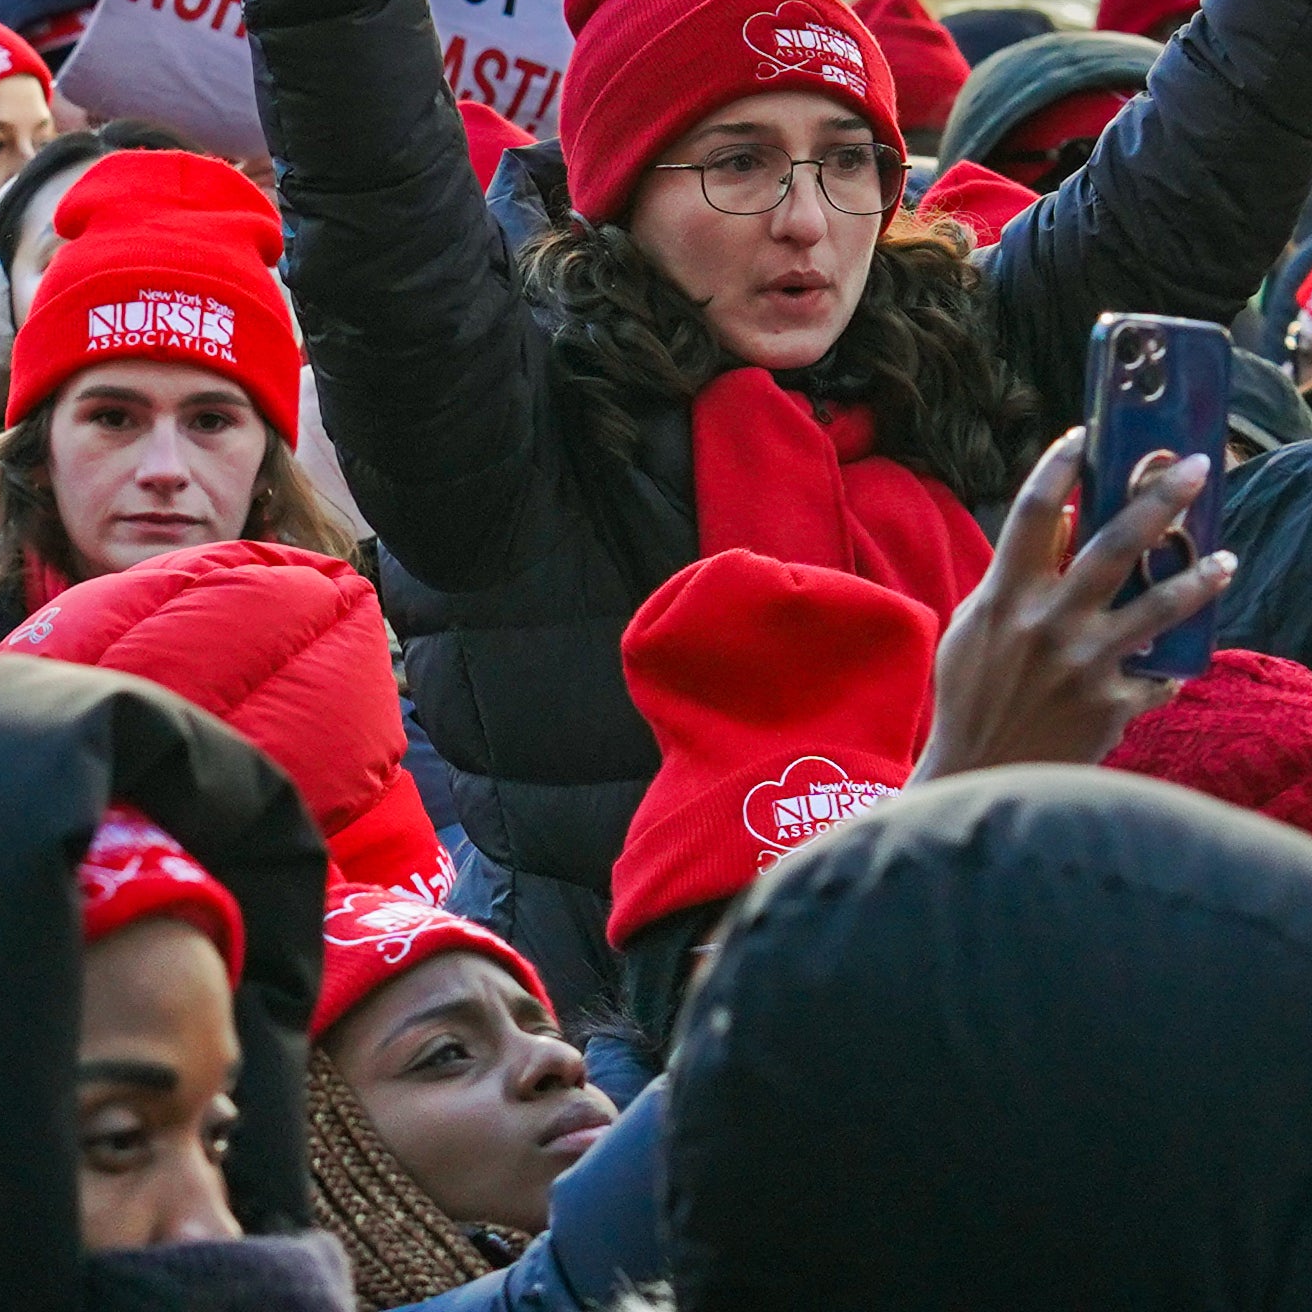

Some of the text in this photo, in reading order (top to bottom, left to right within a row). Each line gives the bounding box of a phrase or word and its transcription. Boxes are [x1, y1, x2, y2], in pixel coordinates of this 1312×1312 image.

[138, 288, 172, 302] New
[173, 289, 203, 307] York
[88, 301, 234, 346] NURSES
[809, 780, 840, 795] New
[840, 779, 875, 794] York
